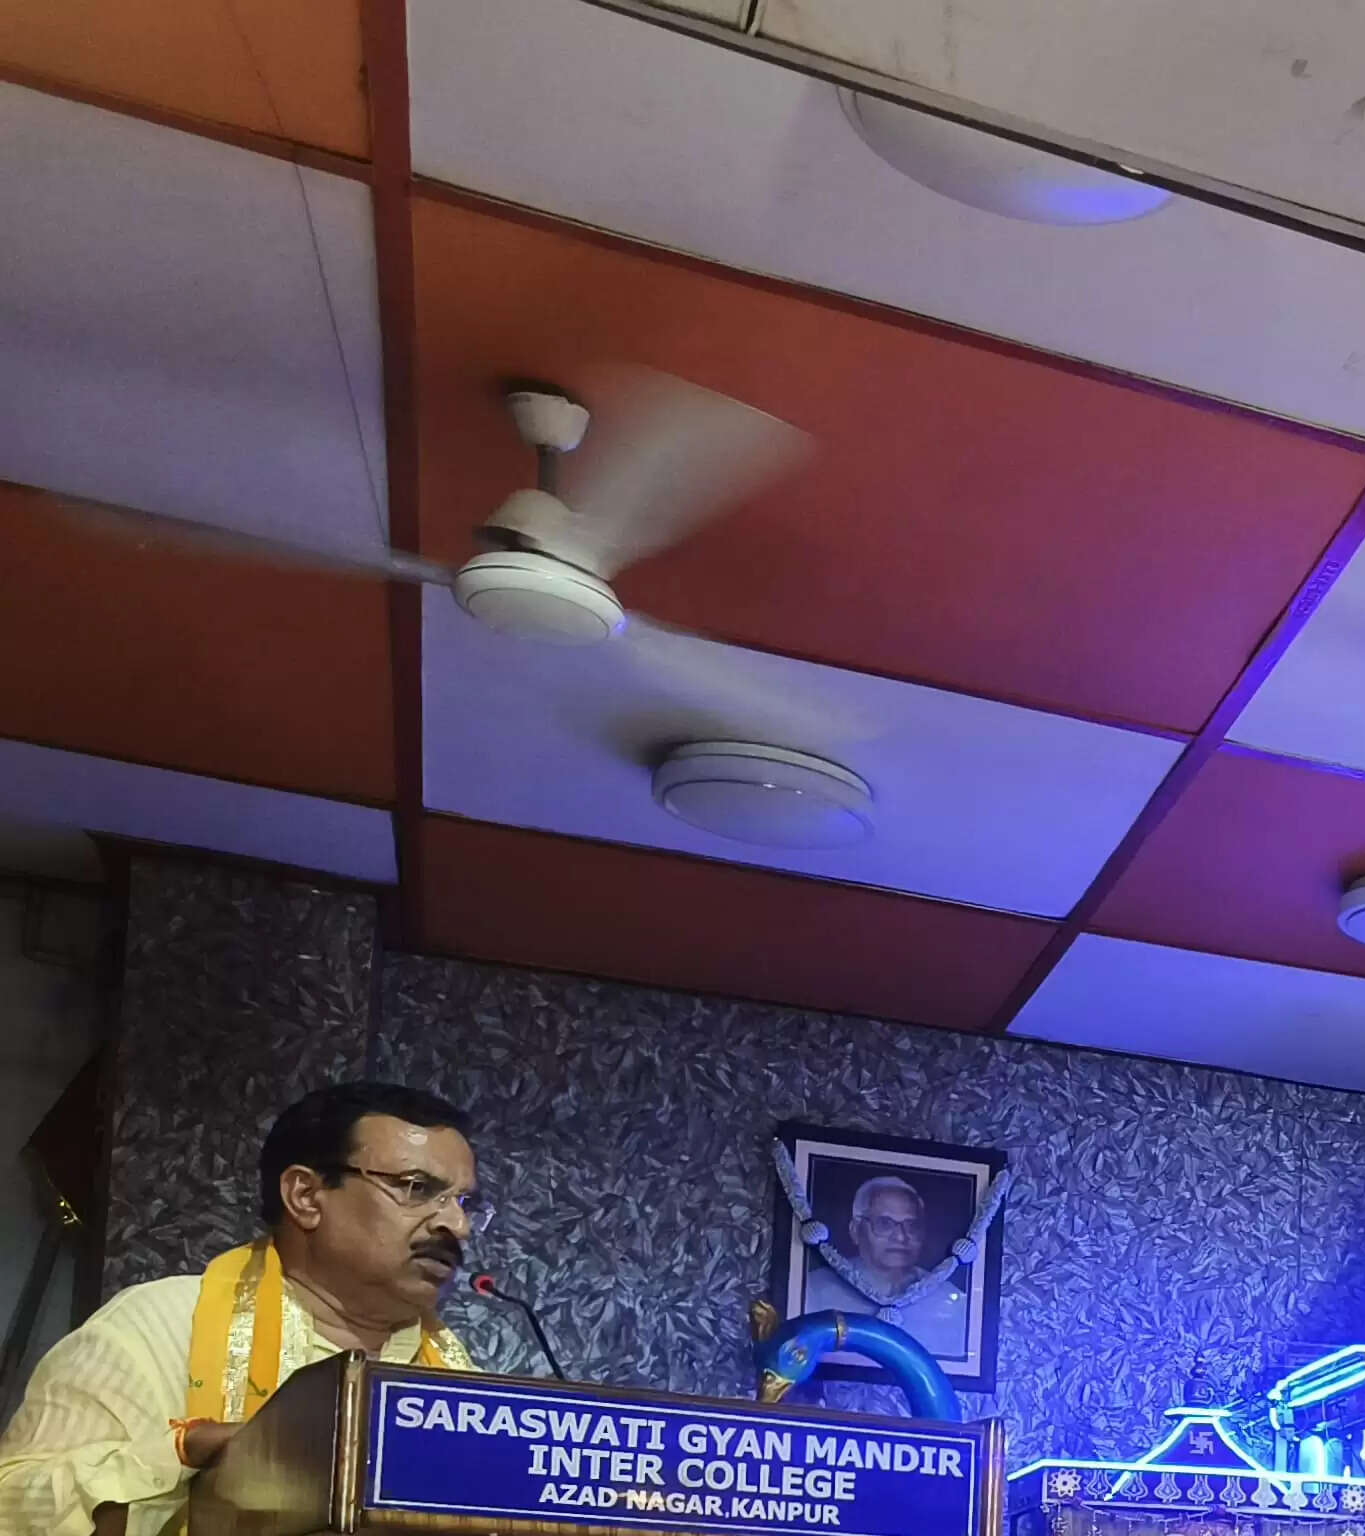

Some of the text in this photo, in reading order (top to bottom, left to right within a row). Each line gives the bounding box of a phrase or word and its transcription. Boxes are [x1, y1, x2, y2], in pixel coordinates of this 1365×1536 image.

[395, 1397, 964, 1478] SARASWATI GYAN MANDIR
[527, 1444, 856, 1500] INTER COLLEGE
[539, 1483, 617, 1509] AZAD
